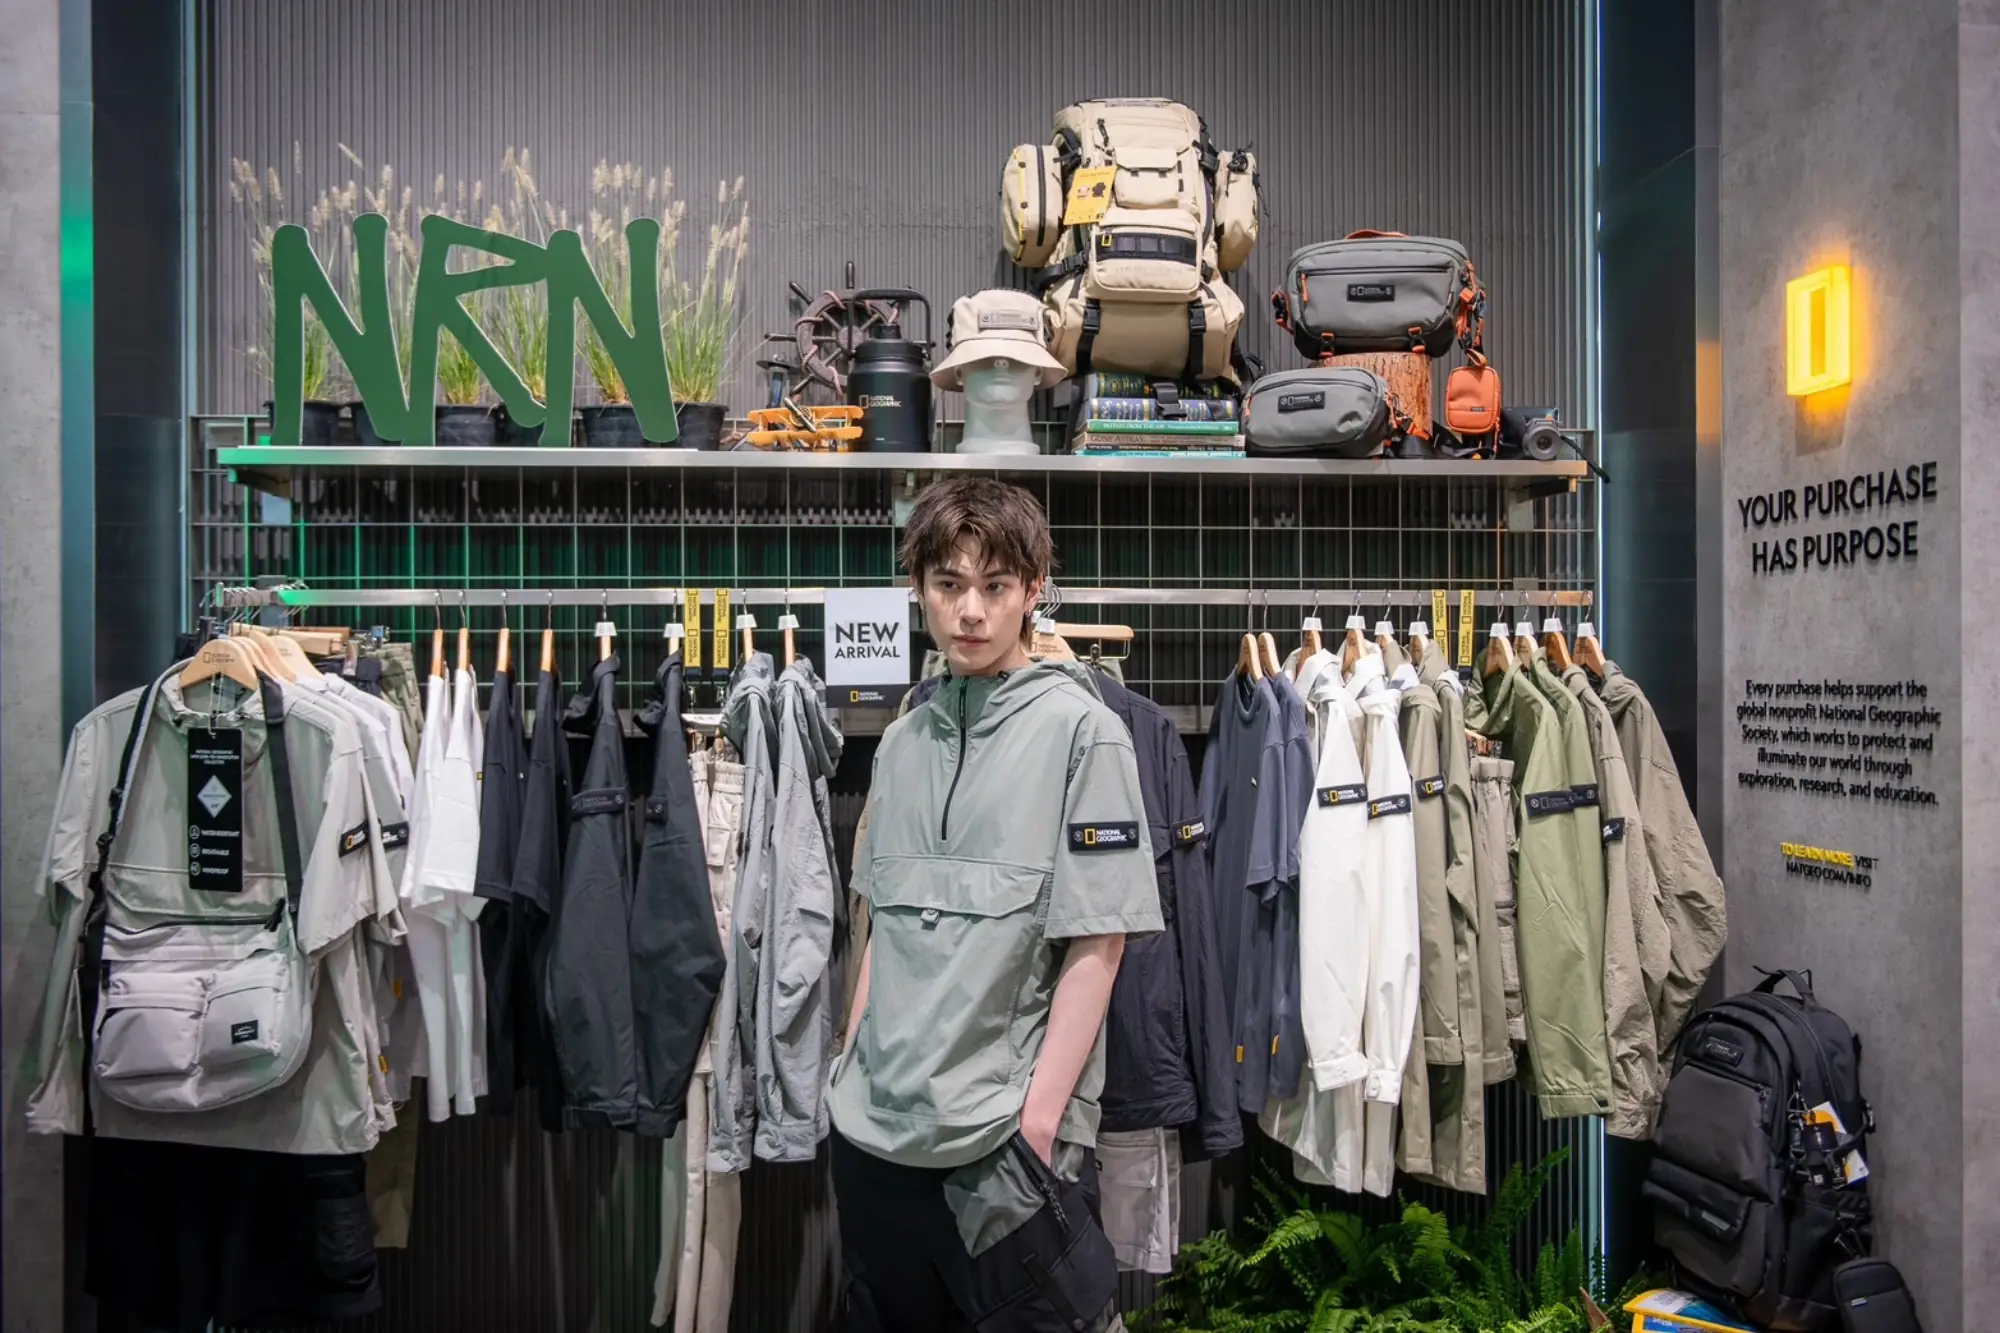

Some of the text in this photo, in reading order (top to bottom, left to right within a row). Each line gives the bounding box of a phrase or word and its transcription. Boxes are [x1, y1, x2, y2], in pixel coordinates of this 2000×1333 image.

[1738, 461, 1937, 530] YOUR PURCHASE
[1752, 520, 1918, 573] HAS PURPOSE
[835, 622, 899, 643] NEW
[834, 646, 900, 659] ARRIVAL
[1746, 678, 1927, 699] Every purchase helps support the
[1736, 701, 1942, 728] global nonprofit National Geographic
[1742, 724, 1933, 750] Society, which works to protect and
[1757, 747, 1913, 779] illuminate our world through
[1738, 769, 1939, 805] exploration, research, and education.
[1096, 834, 1127, 842] GEOGRAPHIC
[1780, 842, 1794, 856] TO
[1855, 855, 1879, 869] VISIT
